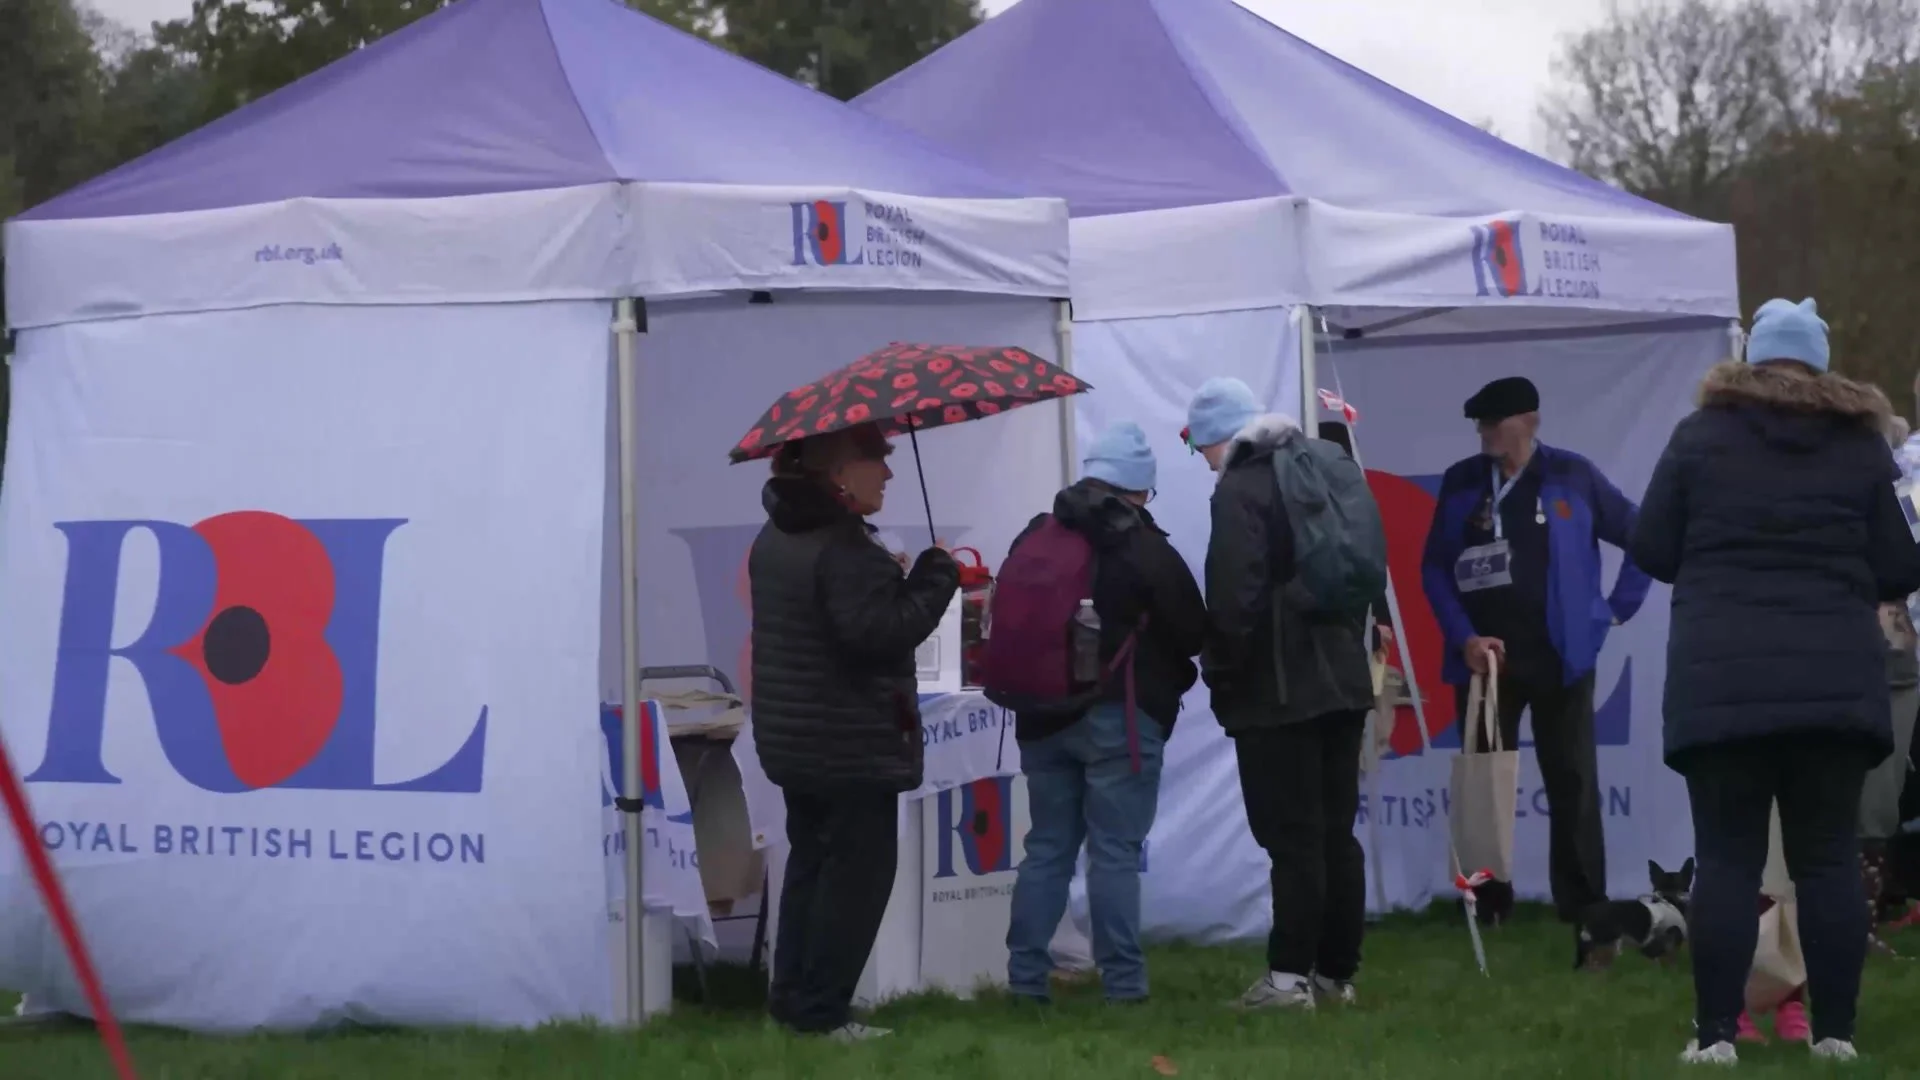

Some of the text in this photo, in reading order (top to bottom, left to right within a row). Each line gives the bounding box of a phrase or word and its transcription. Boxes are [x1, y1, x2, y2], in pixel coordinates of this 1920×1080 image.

[864, 201, 913, 223] ROYAL
[866, 226, 925, 246] BRITISH
[1539, 221, 1587, 245] ROYAL
[254, 243, 343, 265] rbl.org.uk
[867, 250, 922, 268] LEGION
[1544, 250, 1601, 272] BRITISH
[1547, 278, 1600, 299] LEGION
[39, 820, 486, 864] OYAL BRITISH LEGION
[932, 889, 962, 902] ROYAL
